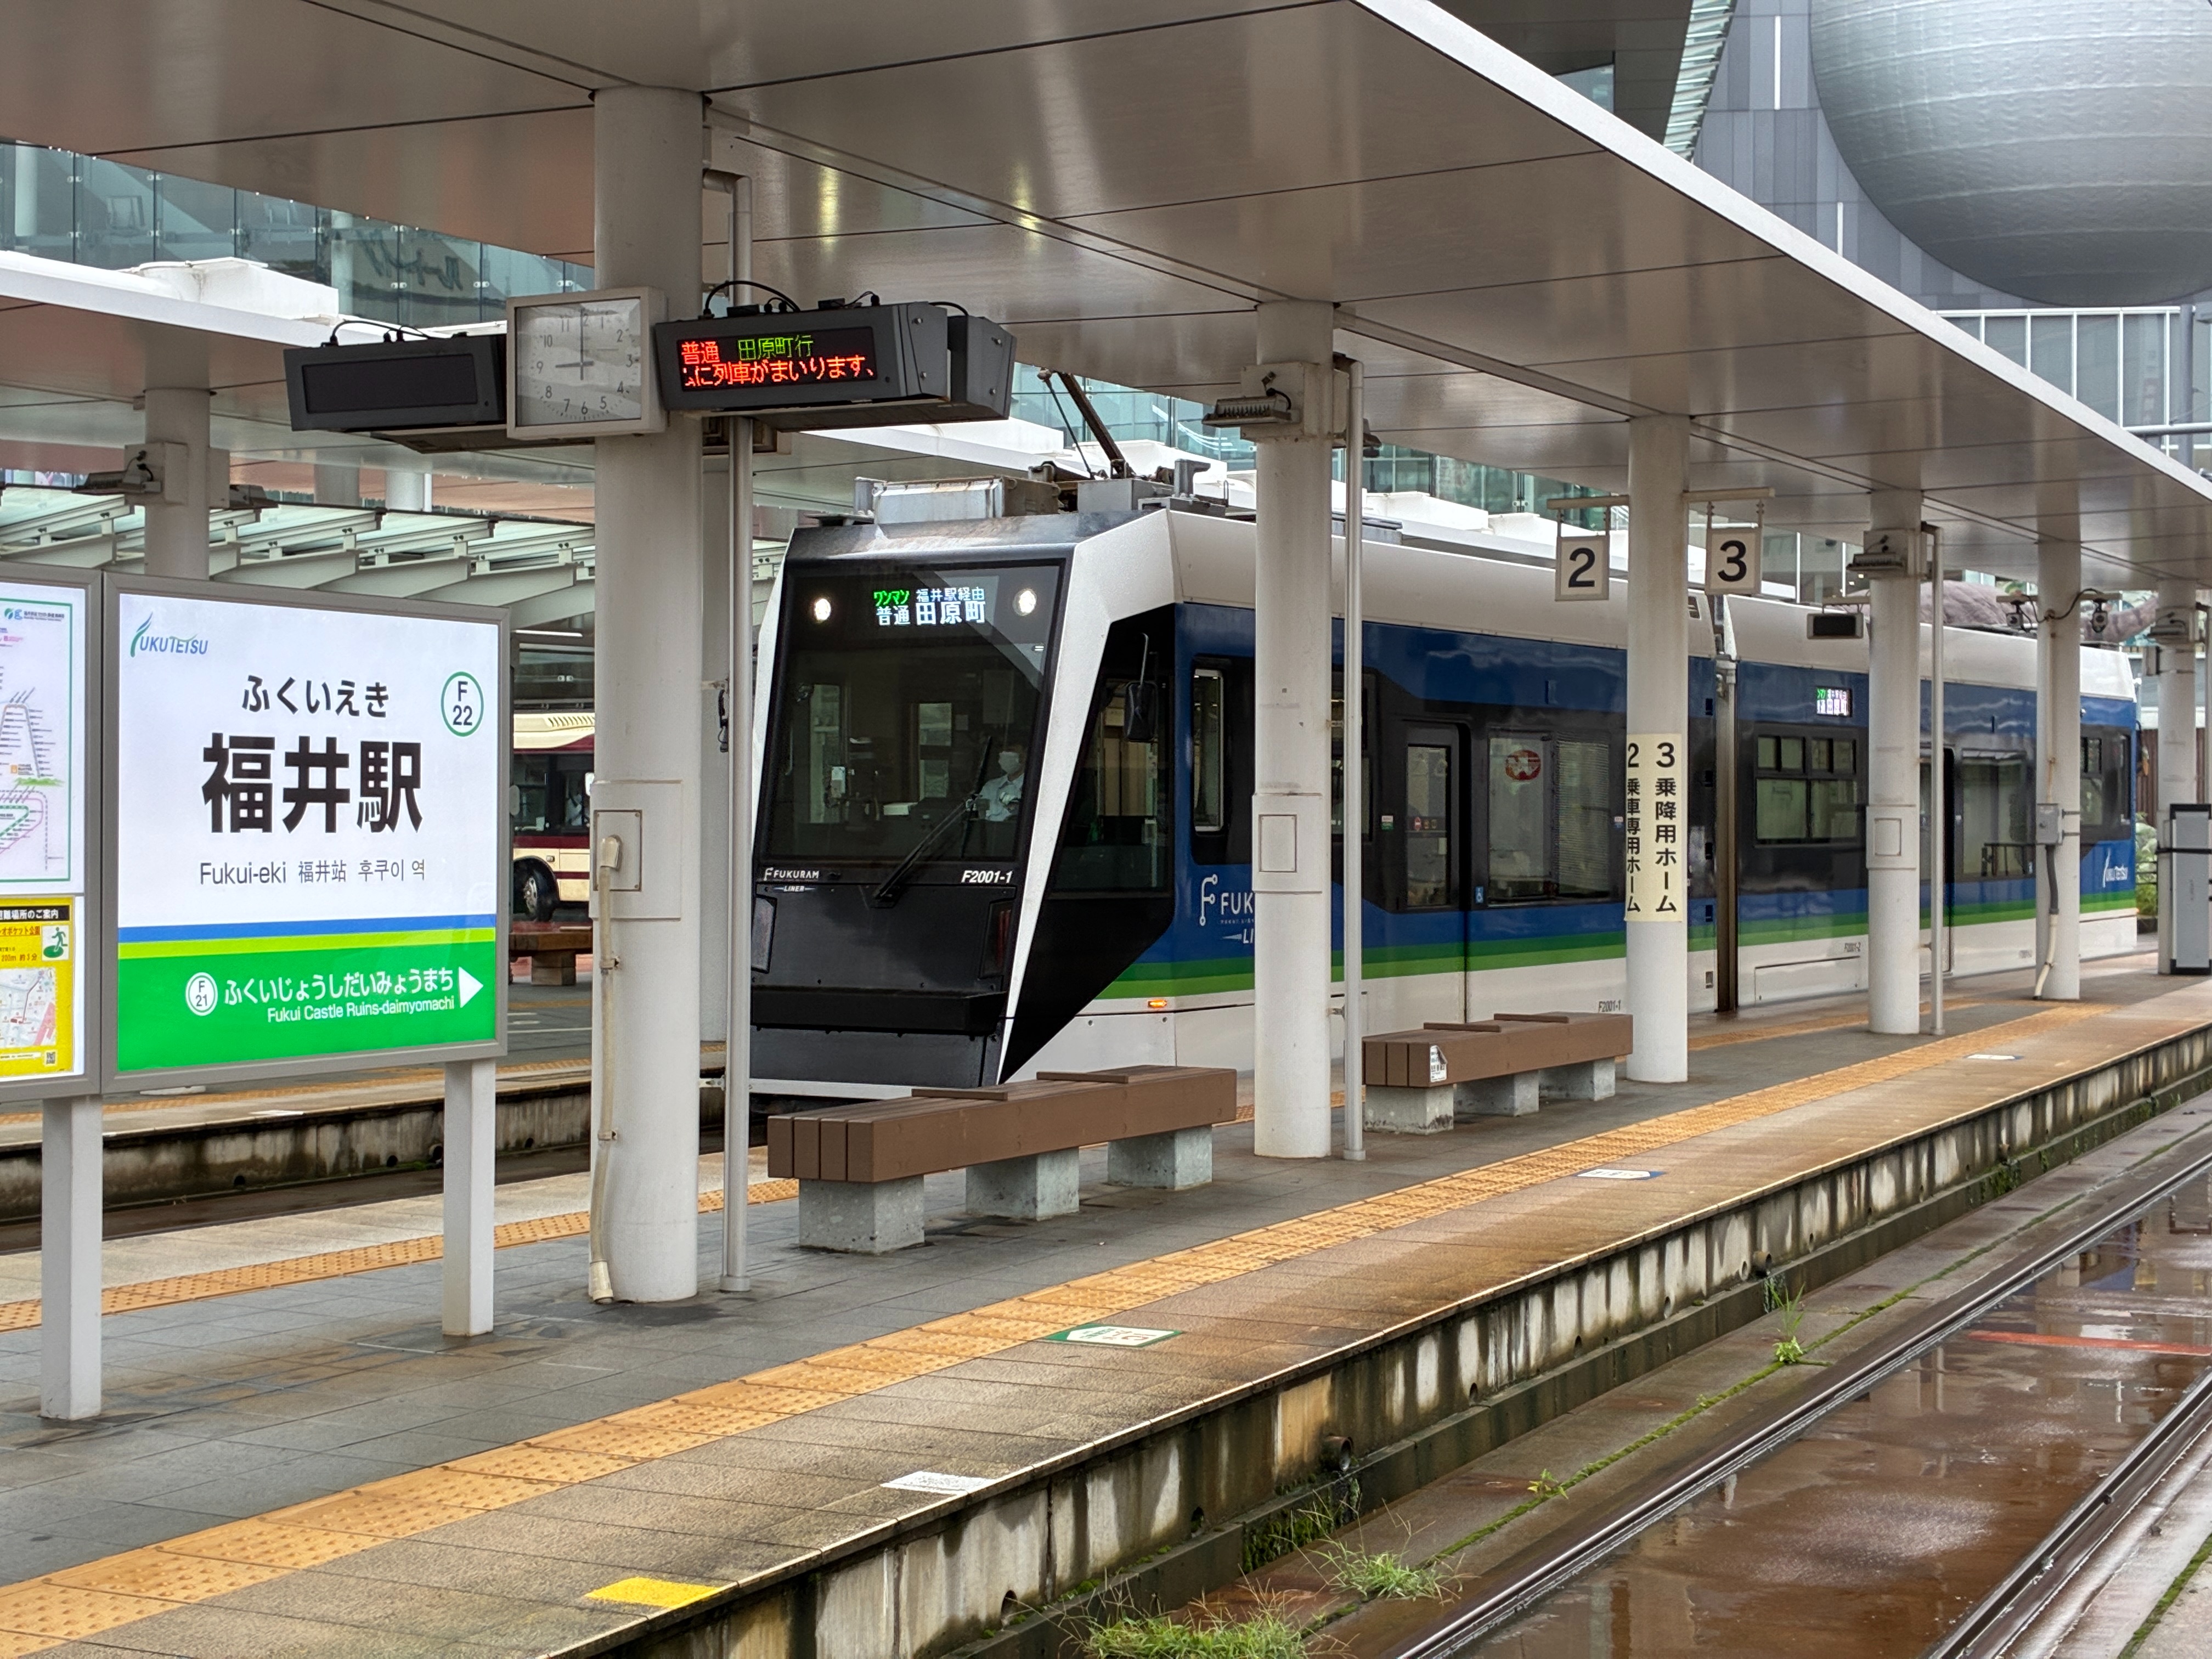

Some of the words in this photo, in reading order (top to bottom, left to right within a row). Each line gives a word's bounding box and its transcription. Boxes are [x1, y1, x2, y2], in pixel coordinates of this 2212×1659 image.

[544, 334, 552, 348] 10
[617, 329, 623, 342] 2
[681, 341, 721, 365] 普通
[738, 334, 814, 360] 田原町行
[537, 361, 543, 374] 9
[626, 354, 633, 368] 3
[545, 385, 552, 399] 8
[617, 381, 624, 394] 4
[564, 398, 571, 413] 7
[581, 401, 588, 415] 6
[600, 396, 607, 410] 5
[1568, 547, 1595, 588] 2
[1717, 540, 1747, 582] 3
[916, 586, 985, 602] 福井駅経由
[876, 606, 911, 625] 普通
[916, 601, 986, 625] 田原町
[241, 675, 389, 718] ふくいえき
[457, 681, 469, 702] F
[453, 705, 473, 726] 22
[201, 732, 423, 834] 福井駅
[200, 861, 286, 885] Fukui-eki
[298, 860, 347, 883] 福井站
[358, 859, 404, 881] 후쿠이
[774, 870, 820, 879] FUKURAM
[961, 870, 1013, 884] F2001-1
[198, 980, 205, 992] F
[224, 966, 454, 1005] ふくいじょうしだいみょうまち
[195, 994, 208, 1007] 21
[268, 1006, 301, 1023] Fukui
[304, 1003, 343, 1020] Castle
[347, 995, 455, 1017] Ruins-daimyomachi
